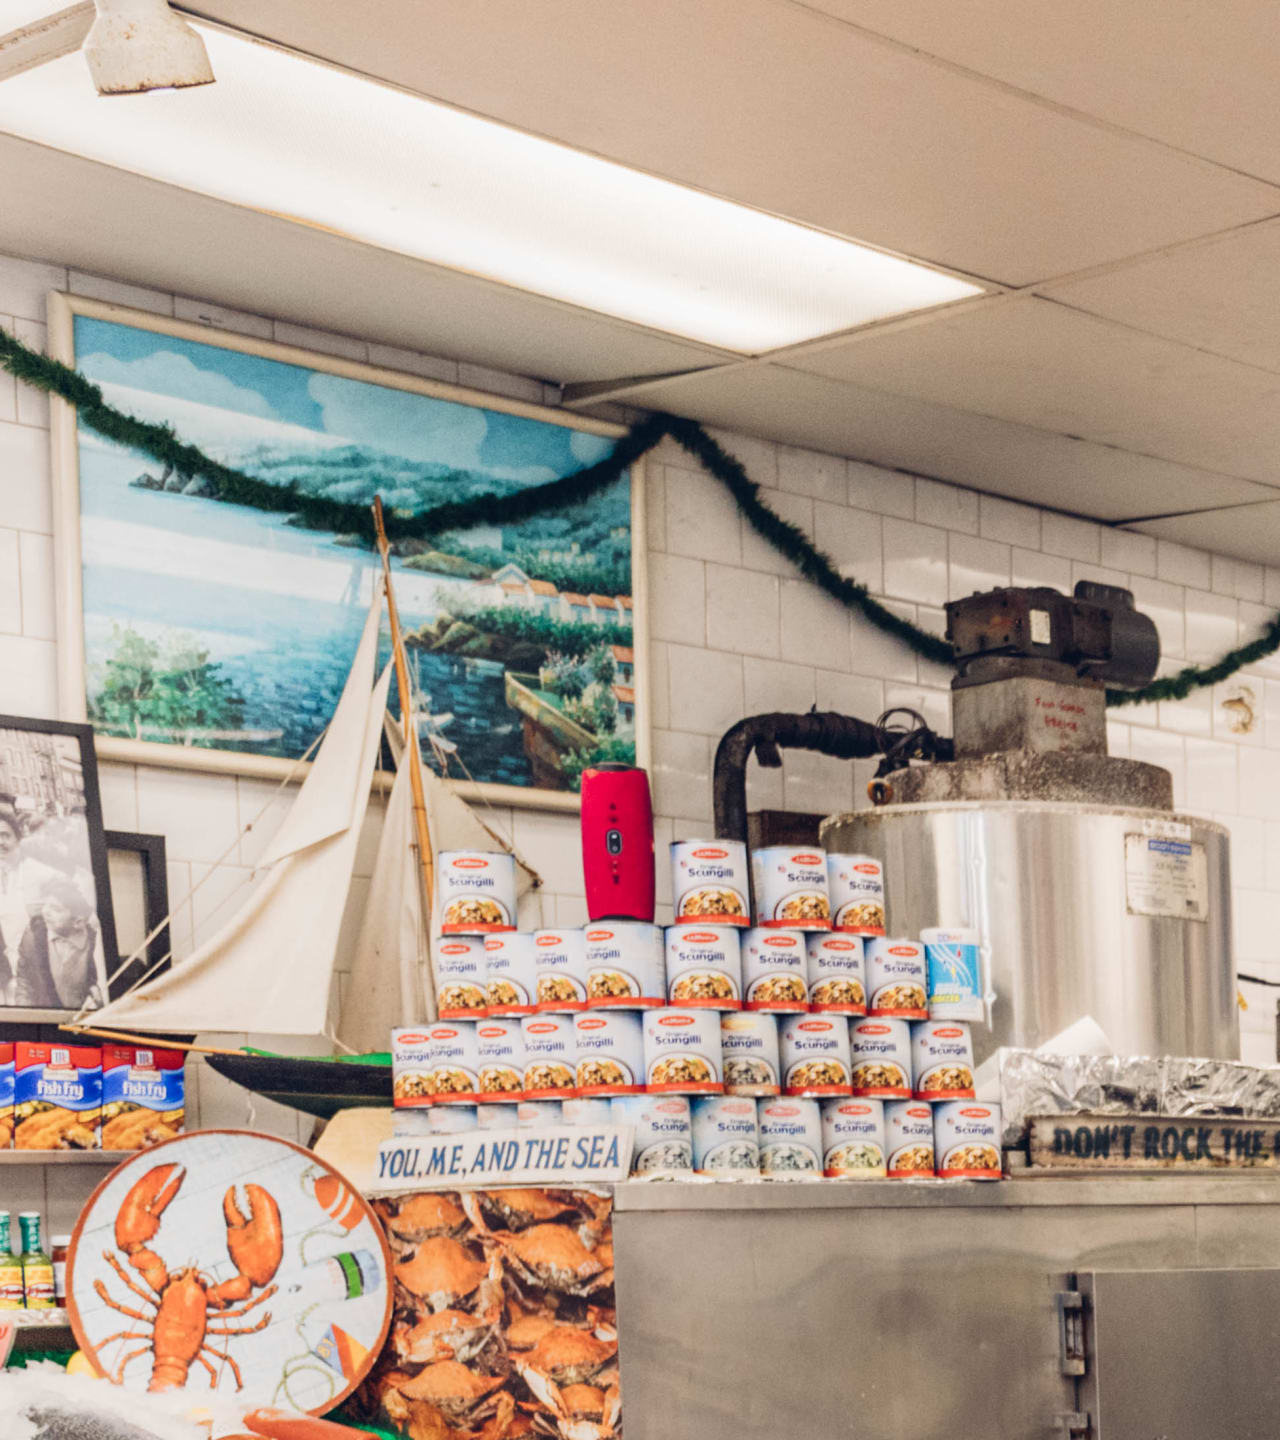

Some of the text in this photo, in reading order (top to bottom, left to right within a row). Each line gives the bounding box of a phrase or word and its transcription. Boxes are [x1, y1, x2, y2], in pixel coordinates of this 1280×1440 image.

[688, 867, 734, 878] Scungilli
[787, 872, 825, 884] Scungil
[449, 877, 494, 888] Scungilli
[679, 951, 725, 962] Scungilli
[818, 958, 859, 969] Scungilli
[655, 1035, 701, 1046] Scungilli
[795, 1040, 839, 1050] Scungilli
[853, 1043, 897, 1053] Scungilli
[761, 1125, 806, 1136] Scungilli
[834, 1123, 876, 1134] Scungilli
[955, 1125, 994, 1136] Scungilli
[1053, 1125, 1136, 1159] DON'T
[1143, 1126, 1214, 1161] ROCK
[1221, 1128, 1266, 1159] THE
[378, 1135, 620, 1179] YOU, ME, AND THE SEA
